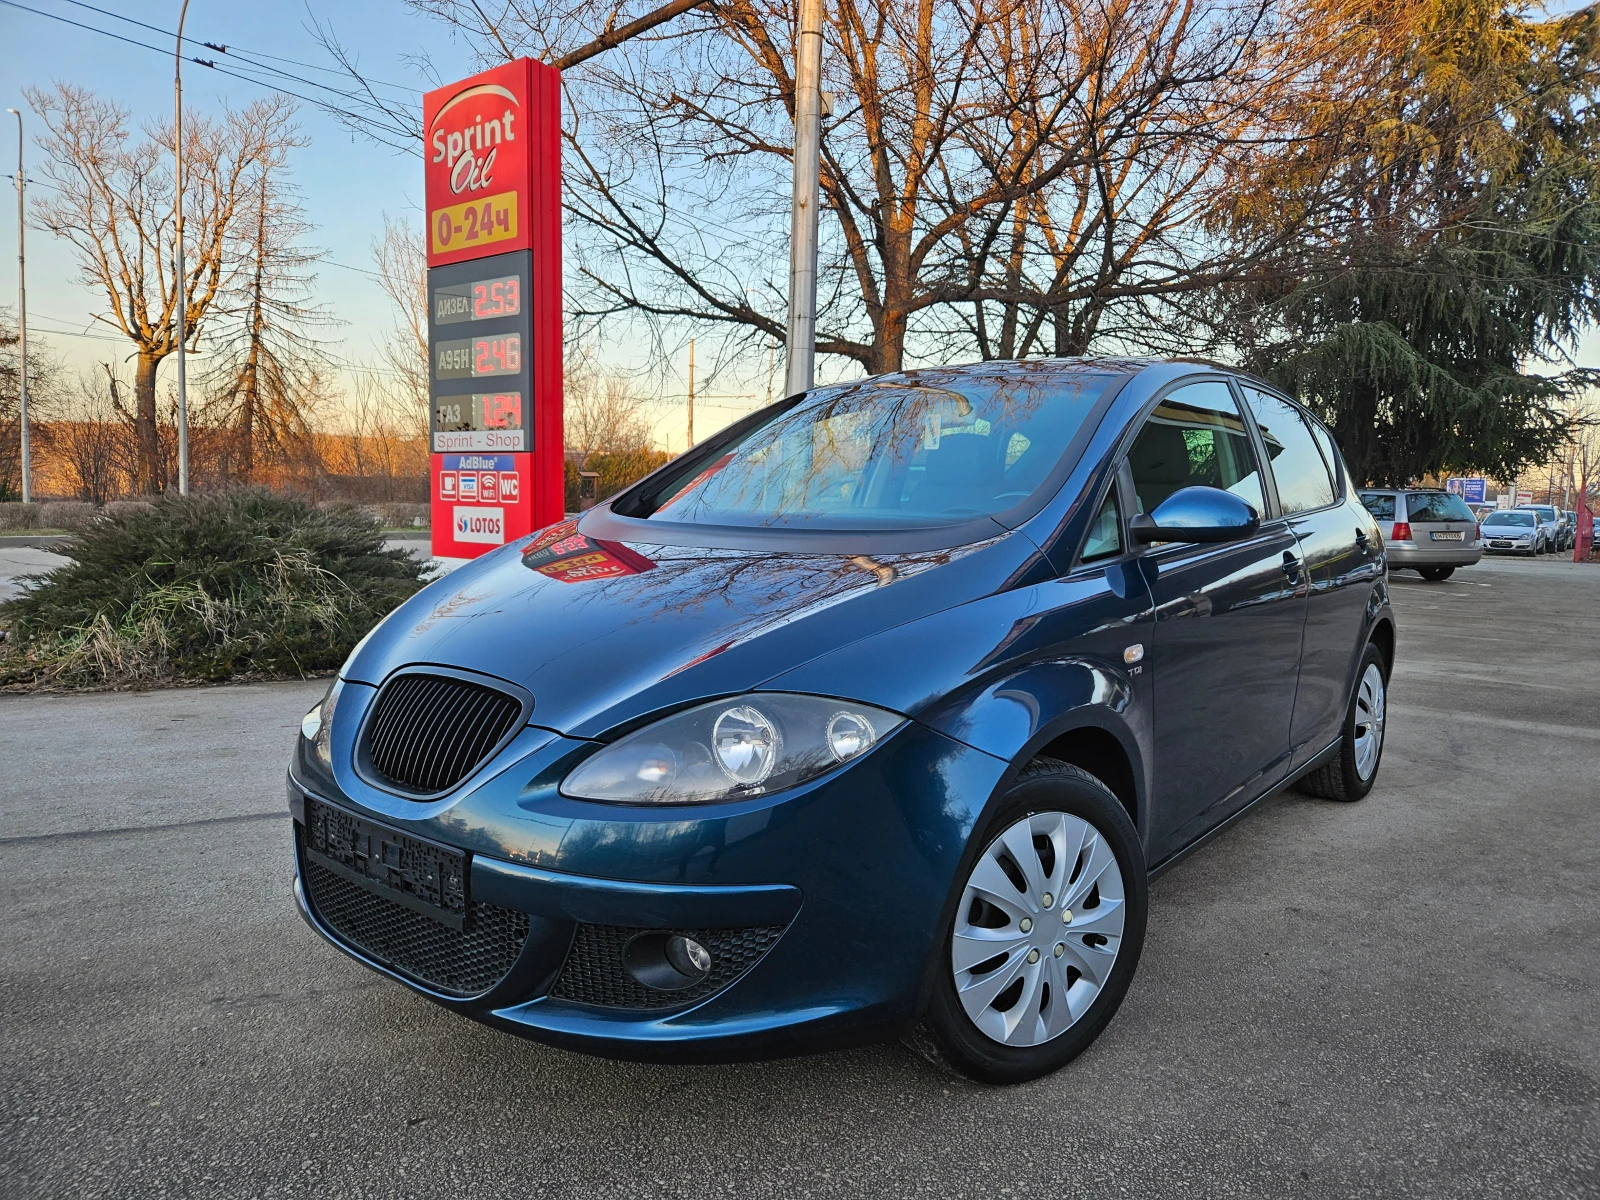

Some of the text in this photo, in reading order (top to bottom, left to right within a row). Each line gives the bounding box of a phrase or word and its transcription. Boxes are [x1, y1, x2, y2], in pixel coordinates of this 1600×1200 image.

[432, 109, 515, 168] Sprint
[450, 146, 497, 195] Oil
[437, 280, 518, 319] ДИЗЕЛ 2.53
[475, 337, 520, 373] 2.46
[439, 404, 461, 423] ГАЗ
[437, 434, 473, 451] Sprint
[486, 433, 520, 449] Shop
[501, 479, 518, 495] WC
[470, 517, 500, 534] LOTOS
[1128, 666, 1142, 678] TDI
